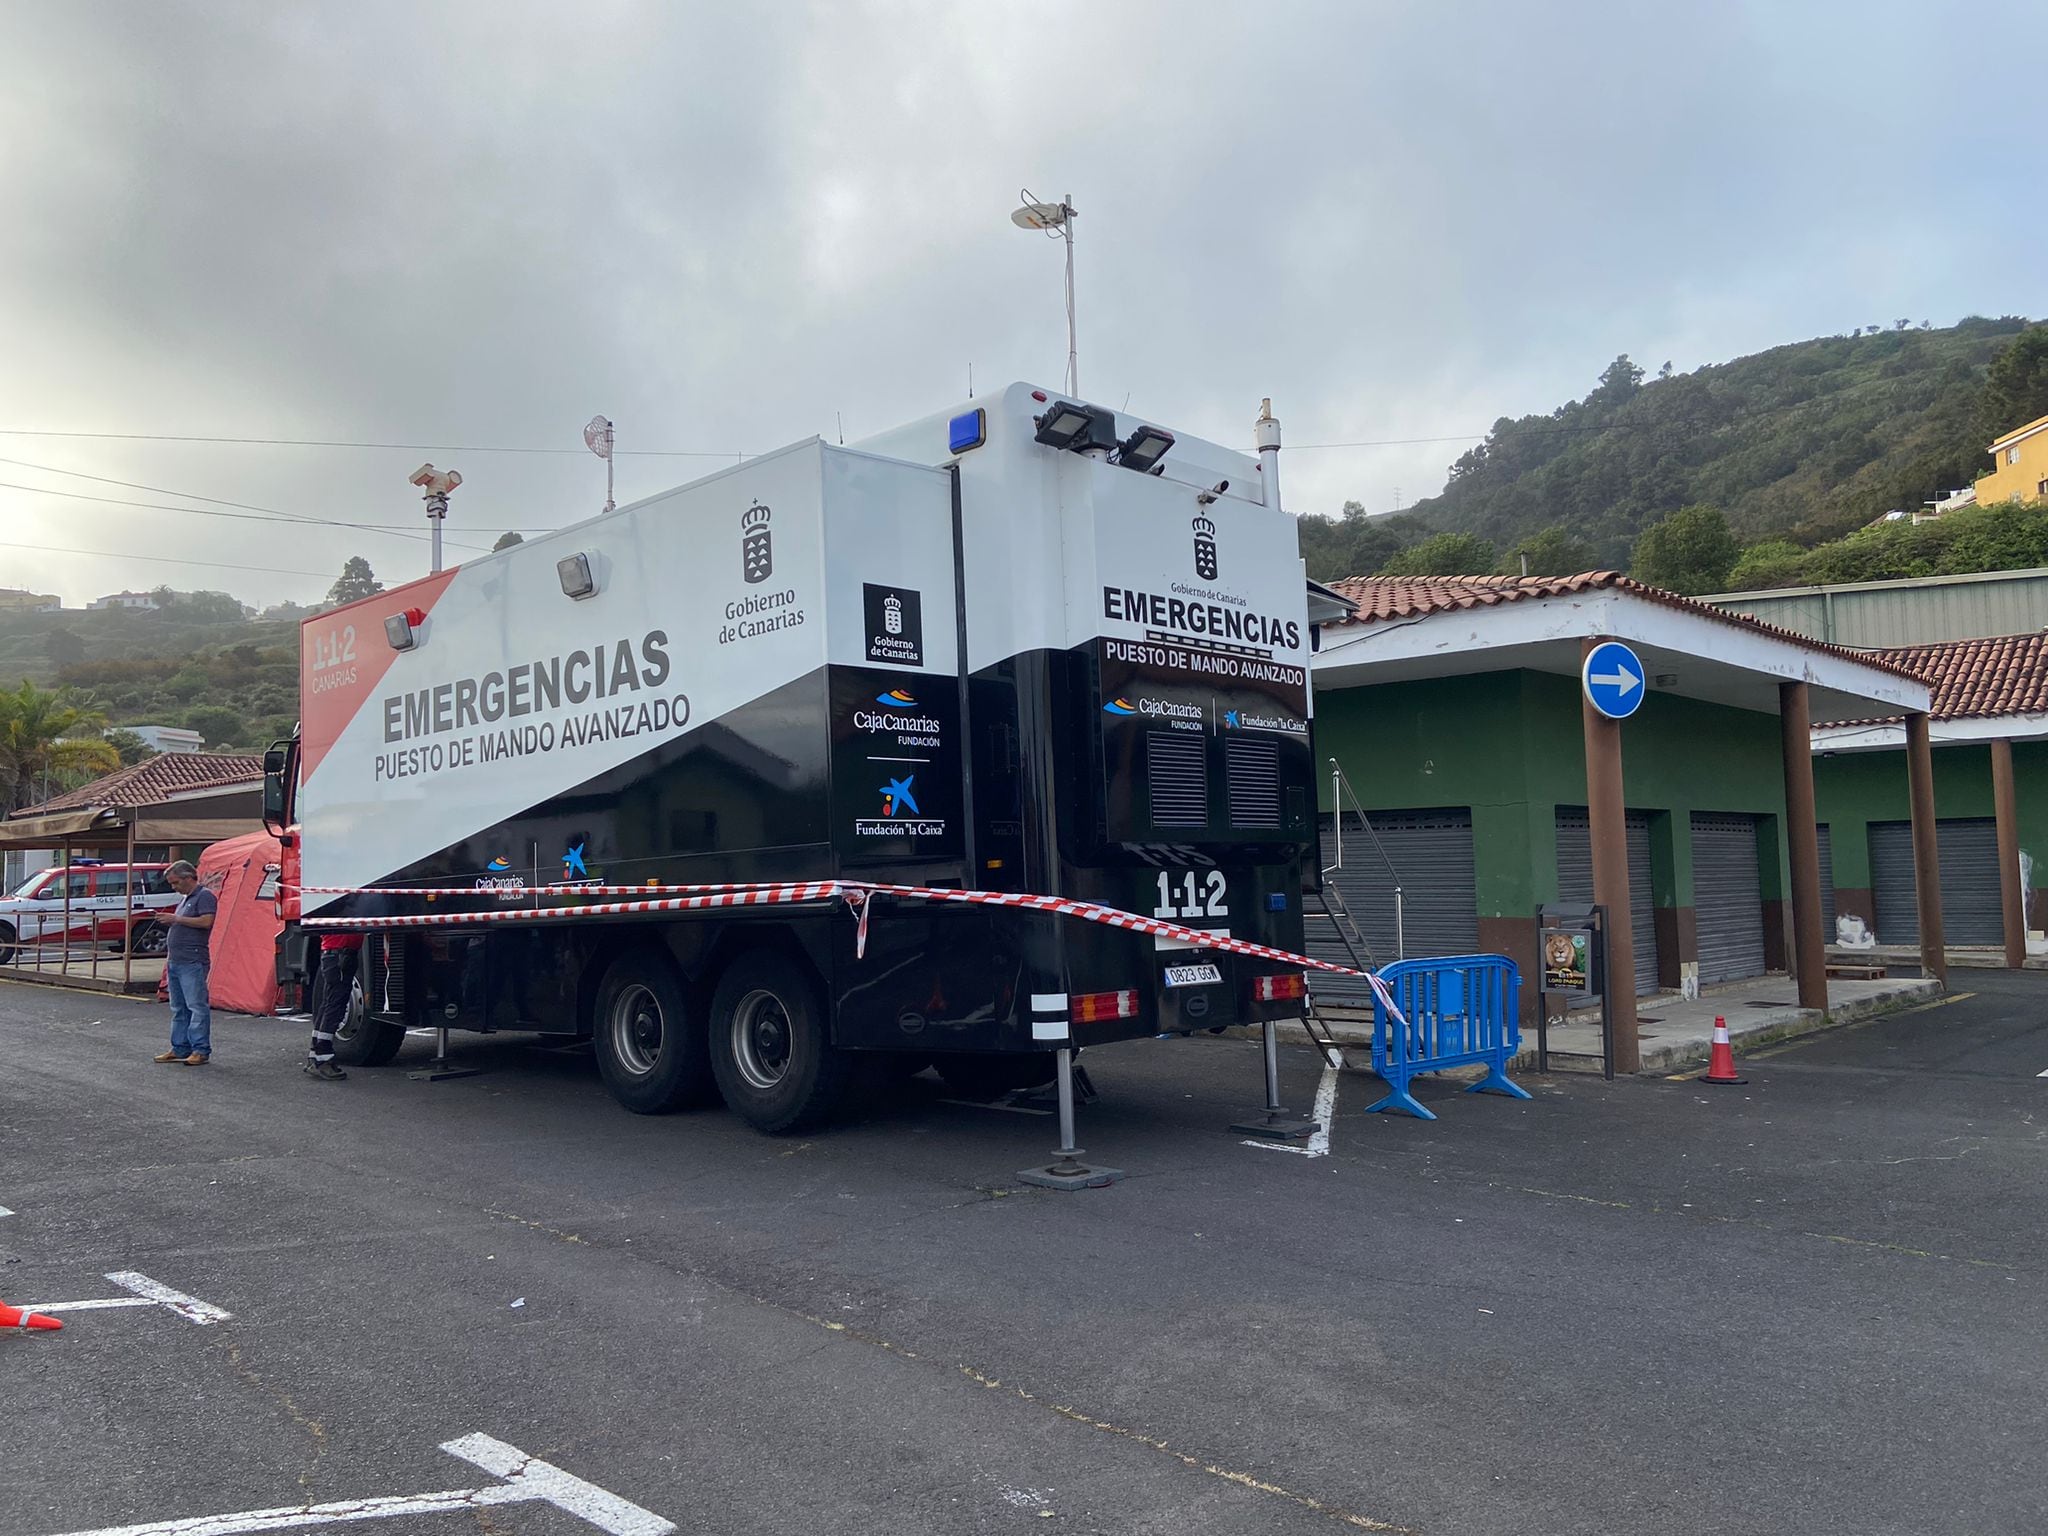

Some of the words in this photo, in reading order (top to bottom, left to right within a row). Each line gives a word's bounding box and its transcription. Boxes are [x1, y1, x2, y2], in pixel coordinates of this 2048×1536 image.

[725, 588, 796, 620] Gobierno
[1171, 581, 1206, 599] Gobierno
[1206, 590, 1216, 600] de
[1216, 591, 1247, 607] Canarias
[718, 624, 736, 645] de
[738, 608, 805, 640] Canarias
[1103, 586, 1300, 651] EMERGENCIAS
[870, 645, 881, 656] de
[881, 646, 919, 661] Canarias
[874, 635, 914, 651] Gobierno
[1106, 641, 1166, 665] PUESTO
[1169, 649, 1188, 670] DE
[1190, 653, 1238, 677] MANDO
[1240, 662, 1303, 686] AVANZADO
[311, 667, 357, 694] CANARIAS
[384, 630, 671, 744] EMERGENCIAS
[1138, 697, 1203, 719] CajaCanarias
[853, 710, 940, 734] CajaCanarias
[1171, 718, 1203, 731] FUNDACIÓN
[1241, 712, 1278, 729] Fundación
[375, 742, 443, 782] PUESTO
[449, 737, 474, 767] DE
[479, 721, 555, 763] MANDO
[560, 693, 691, 749] AVANZADO
[897, 734, 940, 748] FUNDACIÓN
[856, 822, 904, 837] Fundación
[1170, 968, 1197, 983] 0823
[1197, 966, 1218, 981] GGW
